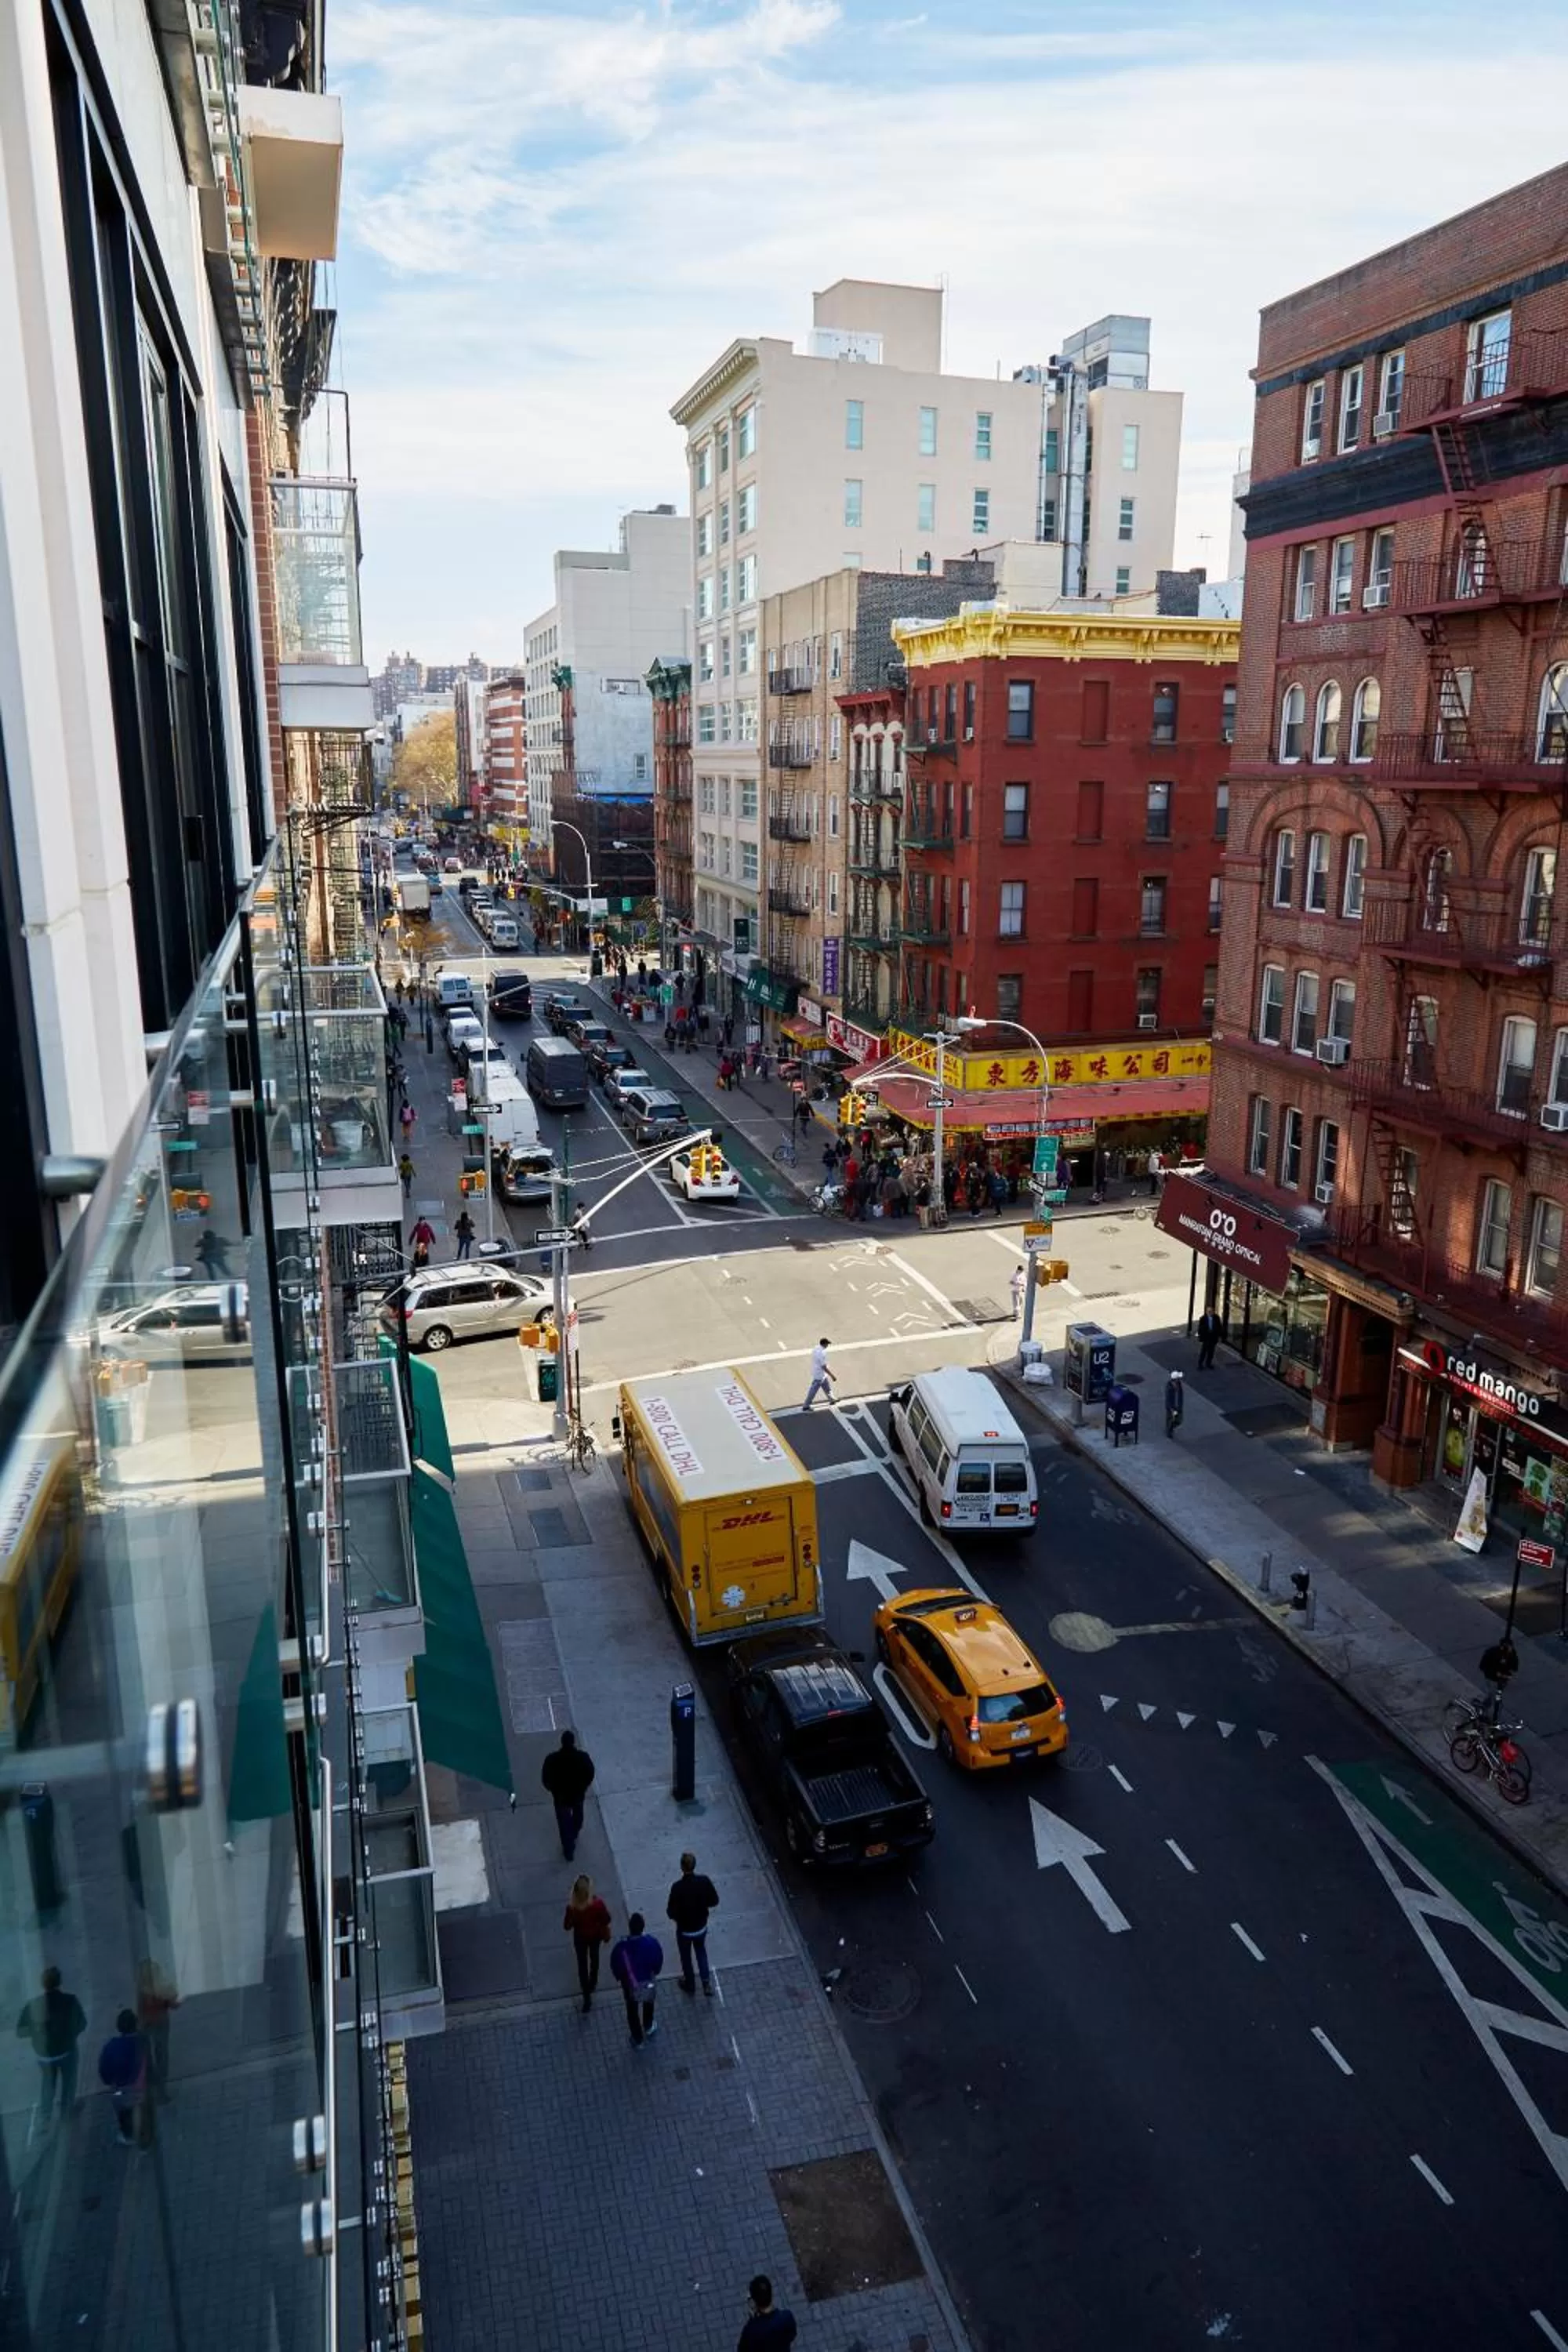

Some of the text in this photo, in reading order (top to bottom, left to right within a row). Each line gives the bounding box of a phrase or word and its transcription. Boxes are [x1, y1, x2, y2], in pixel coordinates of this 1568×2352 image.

[1093, 1351, 1109, 1364] U2
[1446, 1356, 1539, 1415] red mango
[644, 1398, 701, 1476] 1-800 CALL DHL
[720, 1385, 782, 1461] 1-800 CALL DHL
[722, 1510, 775, 1530] DHL
[684, 1707, 691, 1718] P
